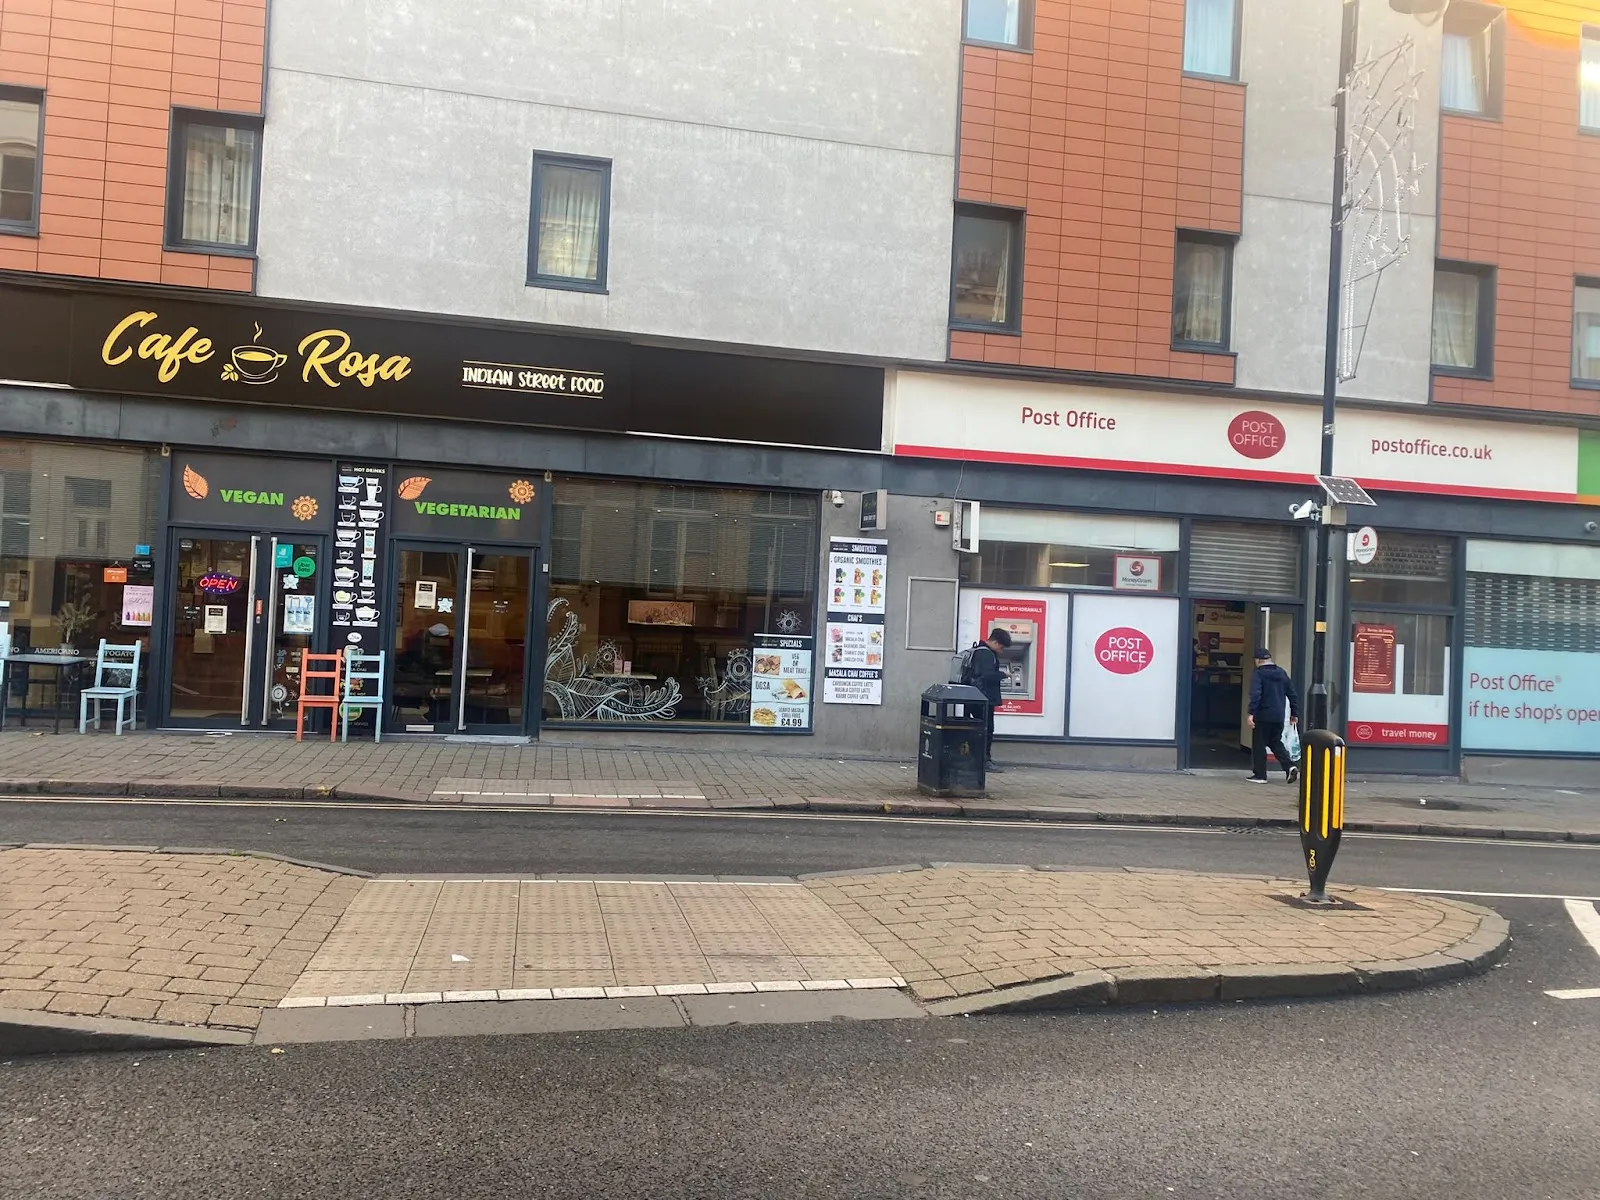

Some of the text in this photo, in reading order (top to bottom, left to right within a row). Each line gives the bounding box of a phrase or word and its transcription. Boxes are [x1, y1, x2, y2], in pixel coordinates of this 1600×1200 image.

[101, 311, 412, 388] Cafe Rosa
[462, 367, 513, 386] INDIAN
[570, 376, 605, 393] FOOD
[1022, 406, 1116, 430] Post Office
[1242, 420, 1275, 434] POST
[1233, 433, 1279, 448] OFFICE
[1371, 438, 1493, 460] postoffice.co.uk
[220, 489, 284, 506] VEGAN
[414, 501, 521, 520] VEGETARIAN
[833, 555, 882, 566] ORGANIC SMOOTHIES
[199, 578, 238, 590] OPEN
[779, 639, 802, 648] SPECIALS
[1108, 636, 1143, 650] POST
[34, 647, 80, 656] AMERICANO
[1100, 649, 1147, 664] OFFICE
[1469, 673, 1505, 690] Post
[1469, 700, 1600, 725] if the shop's ope
[781, 718, 802, 727] £4.99
[1381, 728, 1438, 741] travel money
